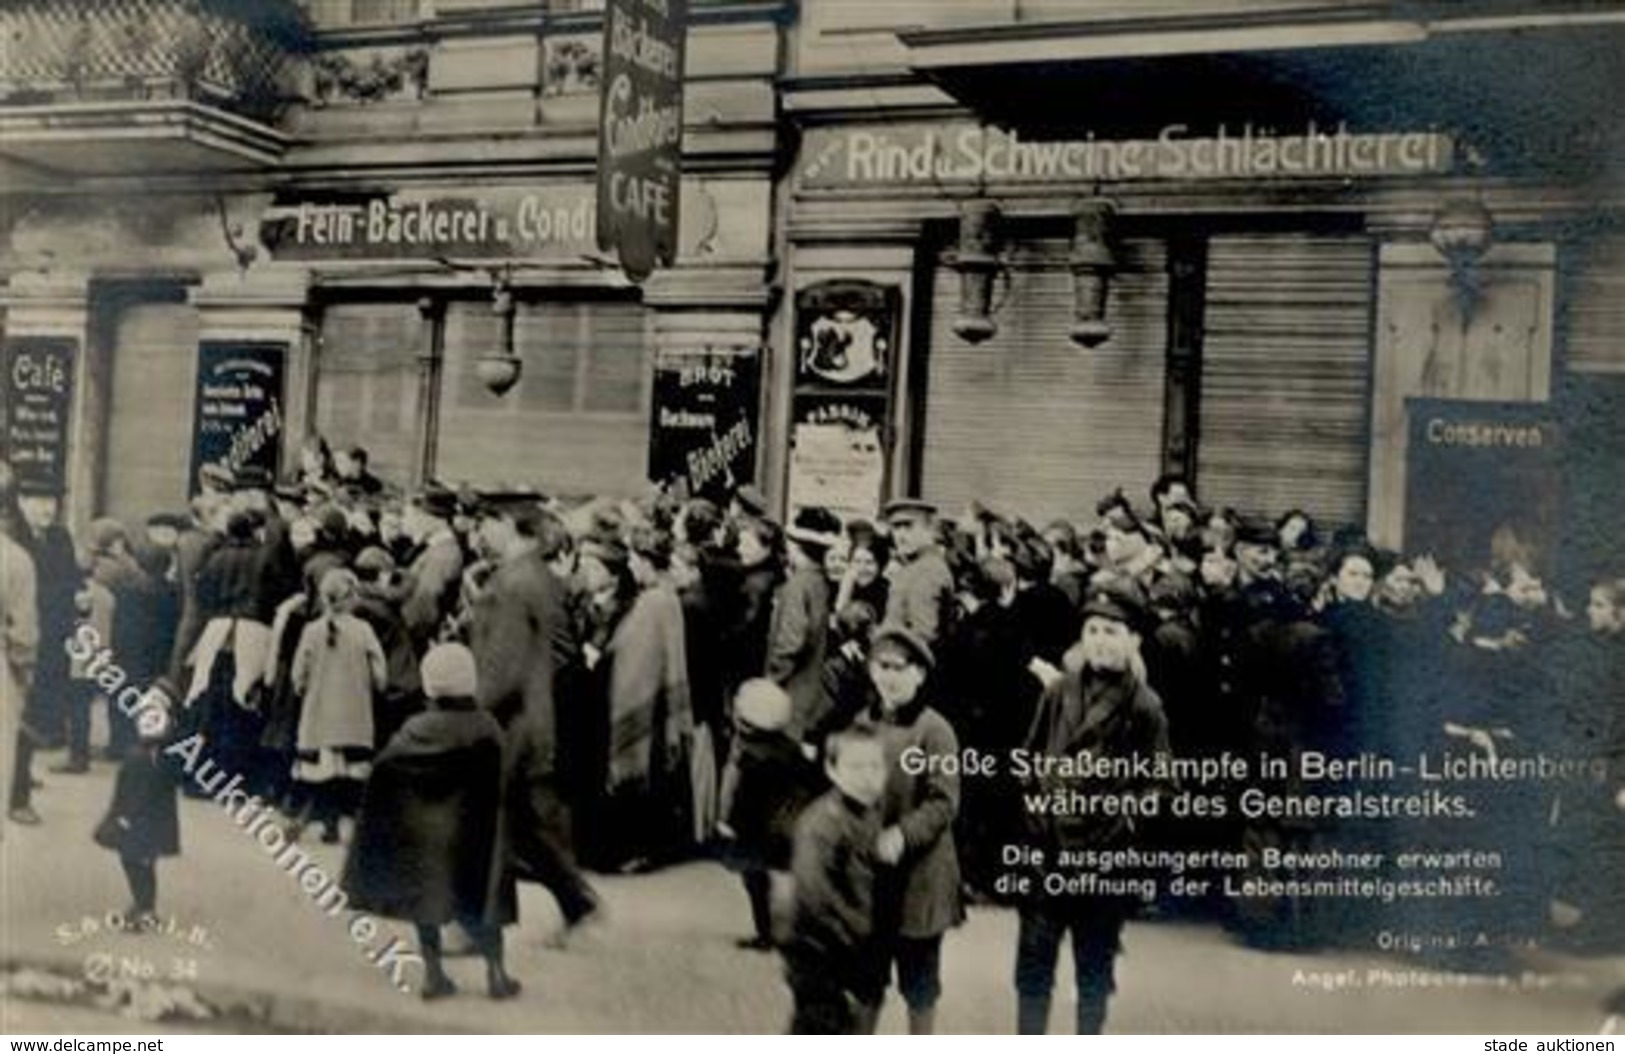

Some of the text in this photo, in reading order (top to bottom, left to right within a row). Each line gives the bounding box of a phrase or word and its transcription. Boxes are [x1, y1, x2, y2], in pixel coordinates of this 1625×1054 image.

[848, 131, 934, 180] Rind
[611, 172, 671, 224] CAFÉ
[1428, 418, 1542, 447] Conserven
